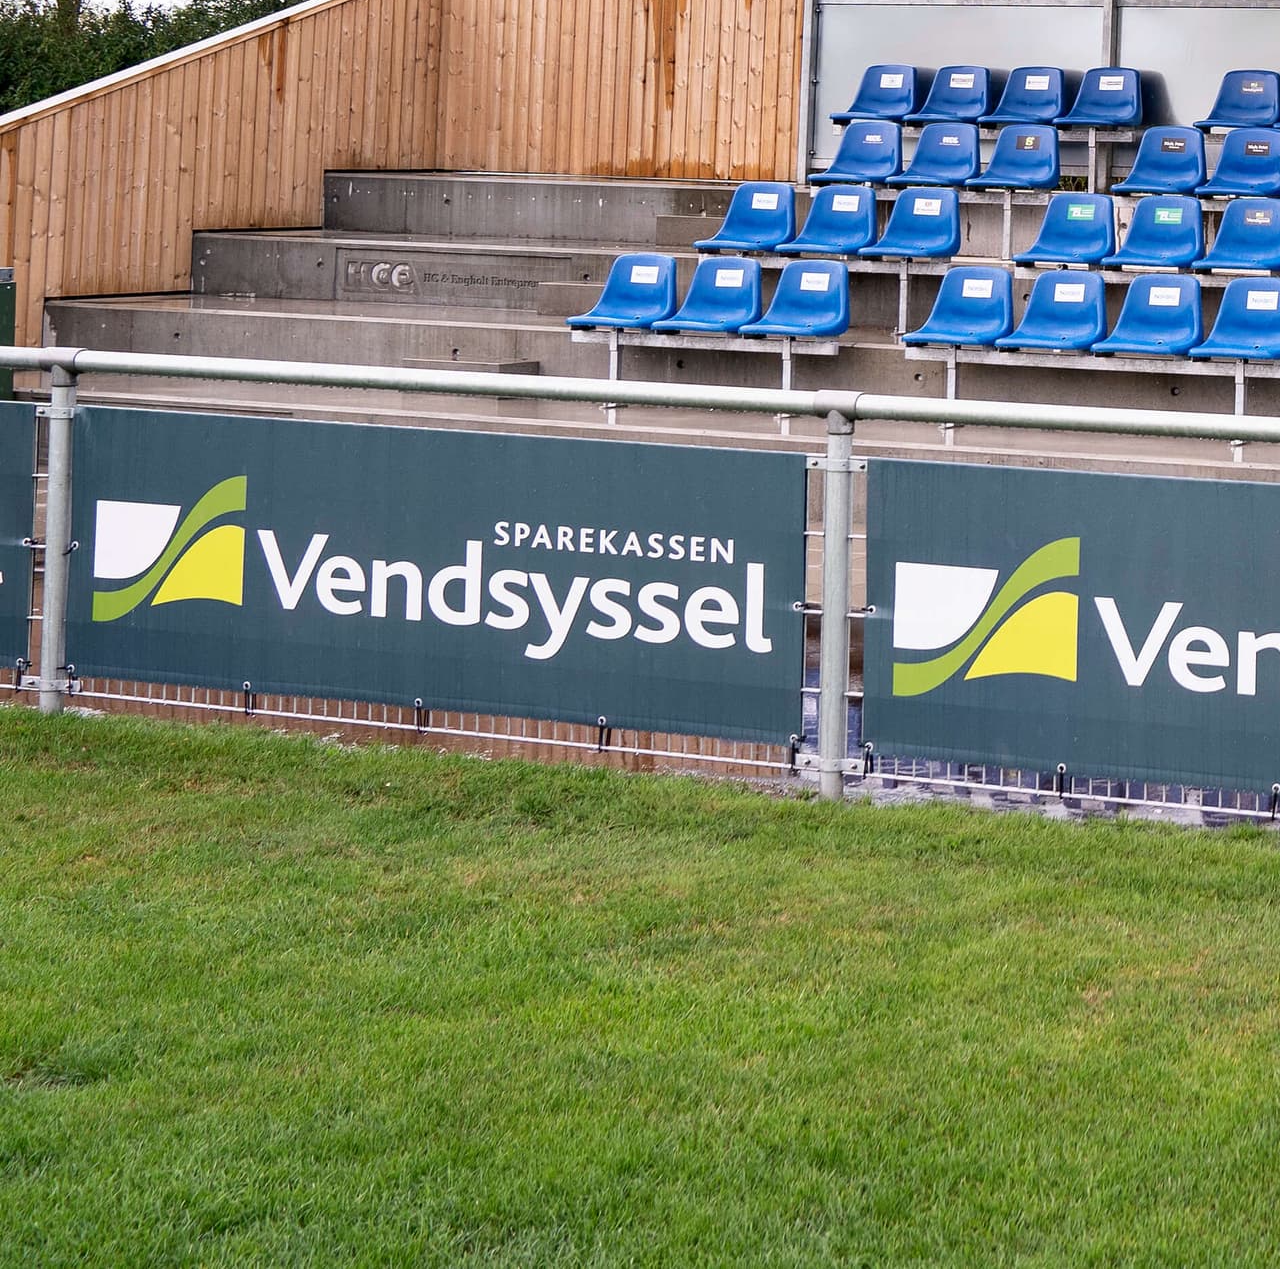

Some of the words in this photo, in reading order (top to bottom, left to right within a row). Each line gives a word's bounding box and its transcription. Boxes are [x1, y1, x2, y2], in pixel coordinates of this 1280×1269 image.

[450, 274, 489, 287] Engholt
[493, 521, 735, 565] SPAREKASSEN
[257, 529, 774, 660] Vendsyssel
